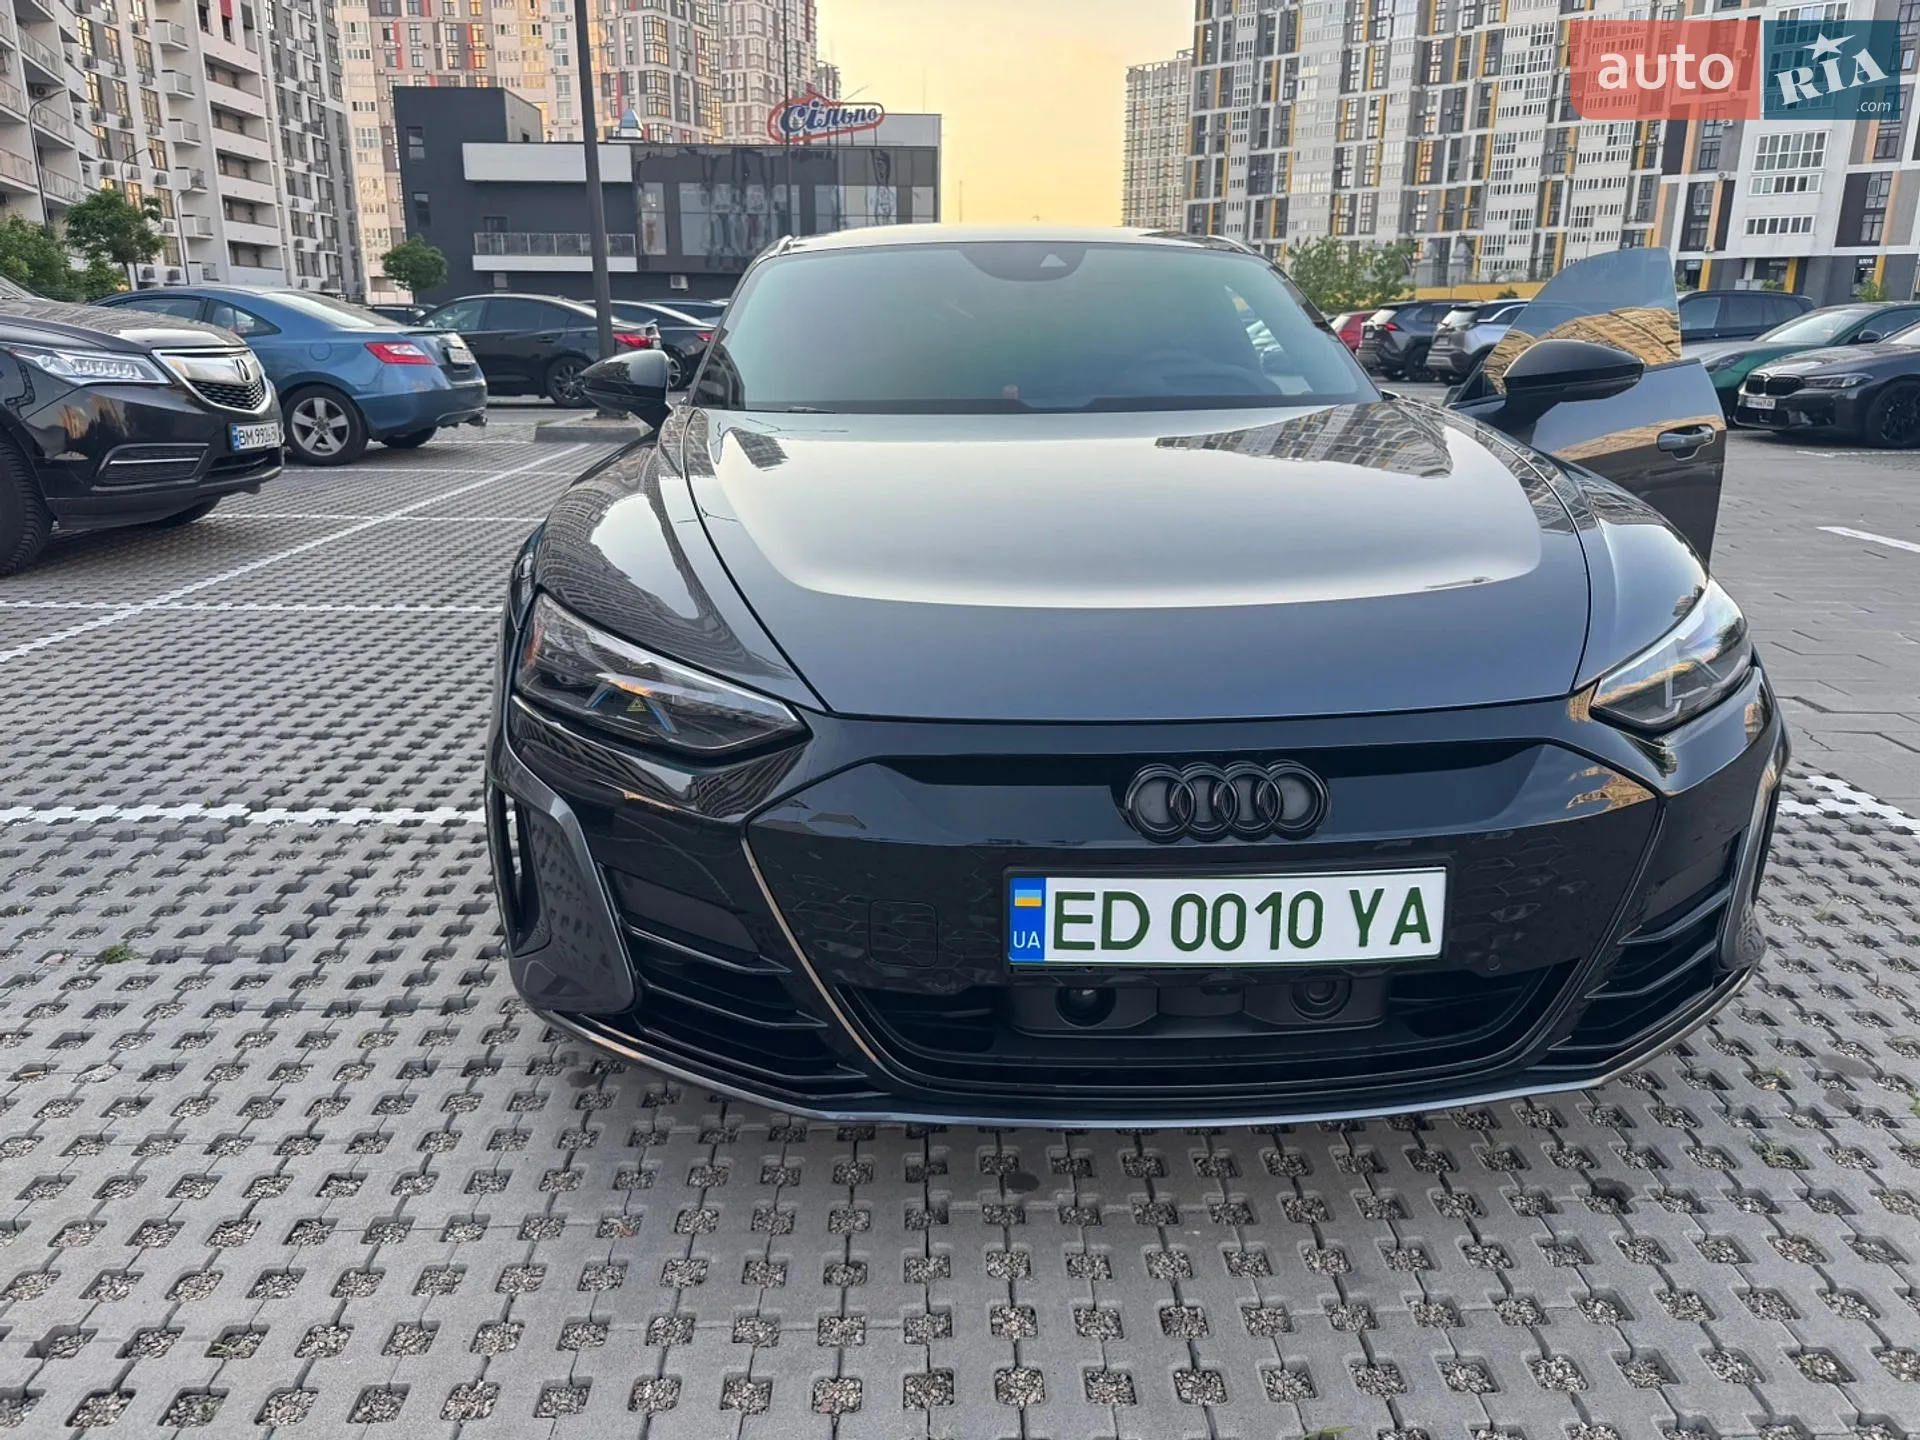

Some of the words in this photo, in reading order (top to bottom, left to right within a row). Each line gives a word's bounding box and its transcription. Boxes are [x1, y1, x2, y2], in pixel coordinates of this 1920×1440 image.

[780, 100, 878, 133] Сільпо
[1053, 890, 1151, 951] ED
[1170, 889, 1324, 952] 0010
[1349, 886, 1431, 948] YA
[1013, 930, 1041, 949] UA
